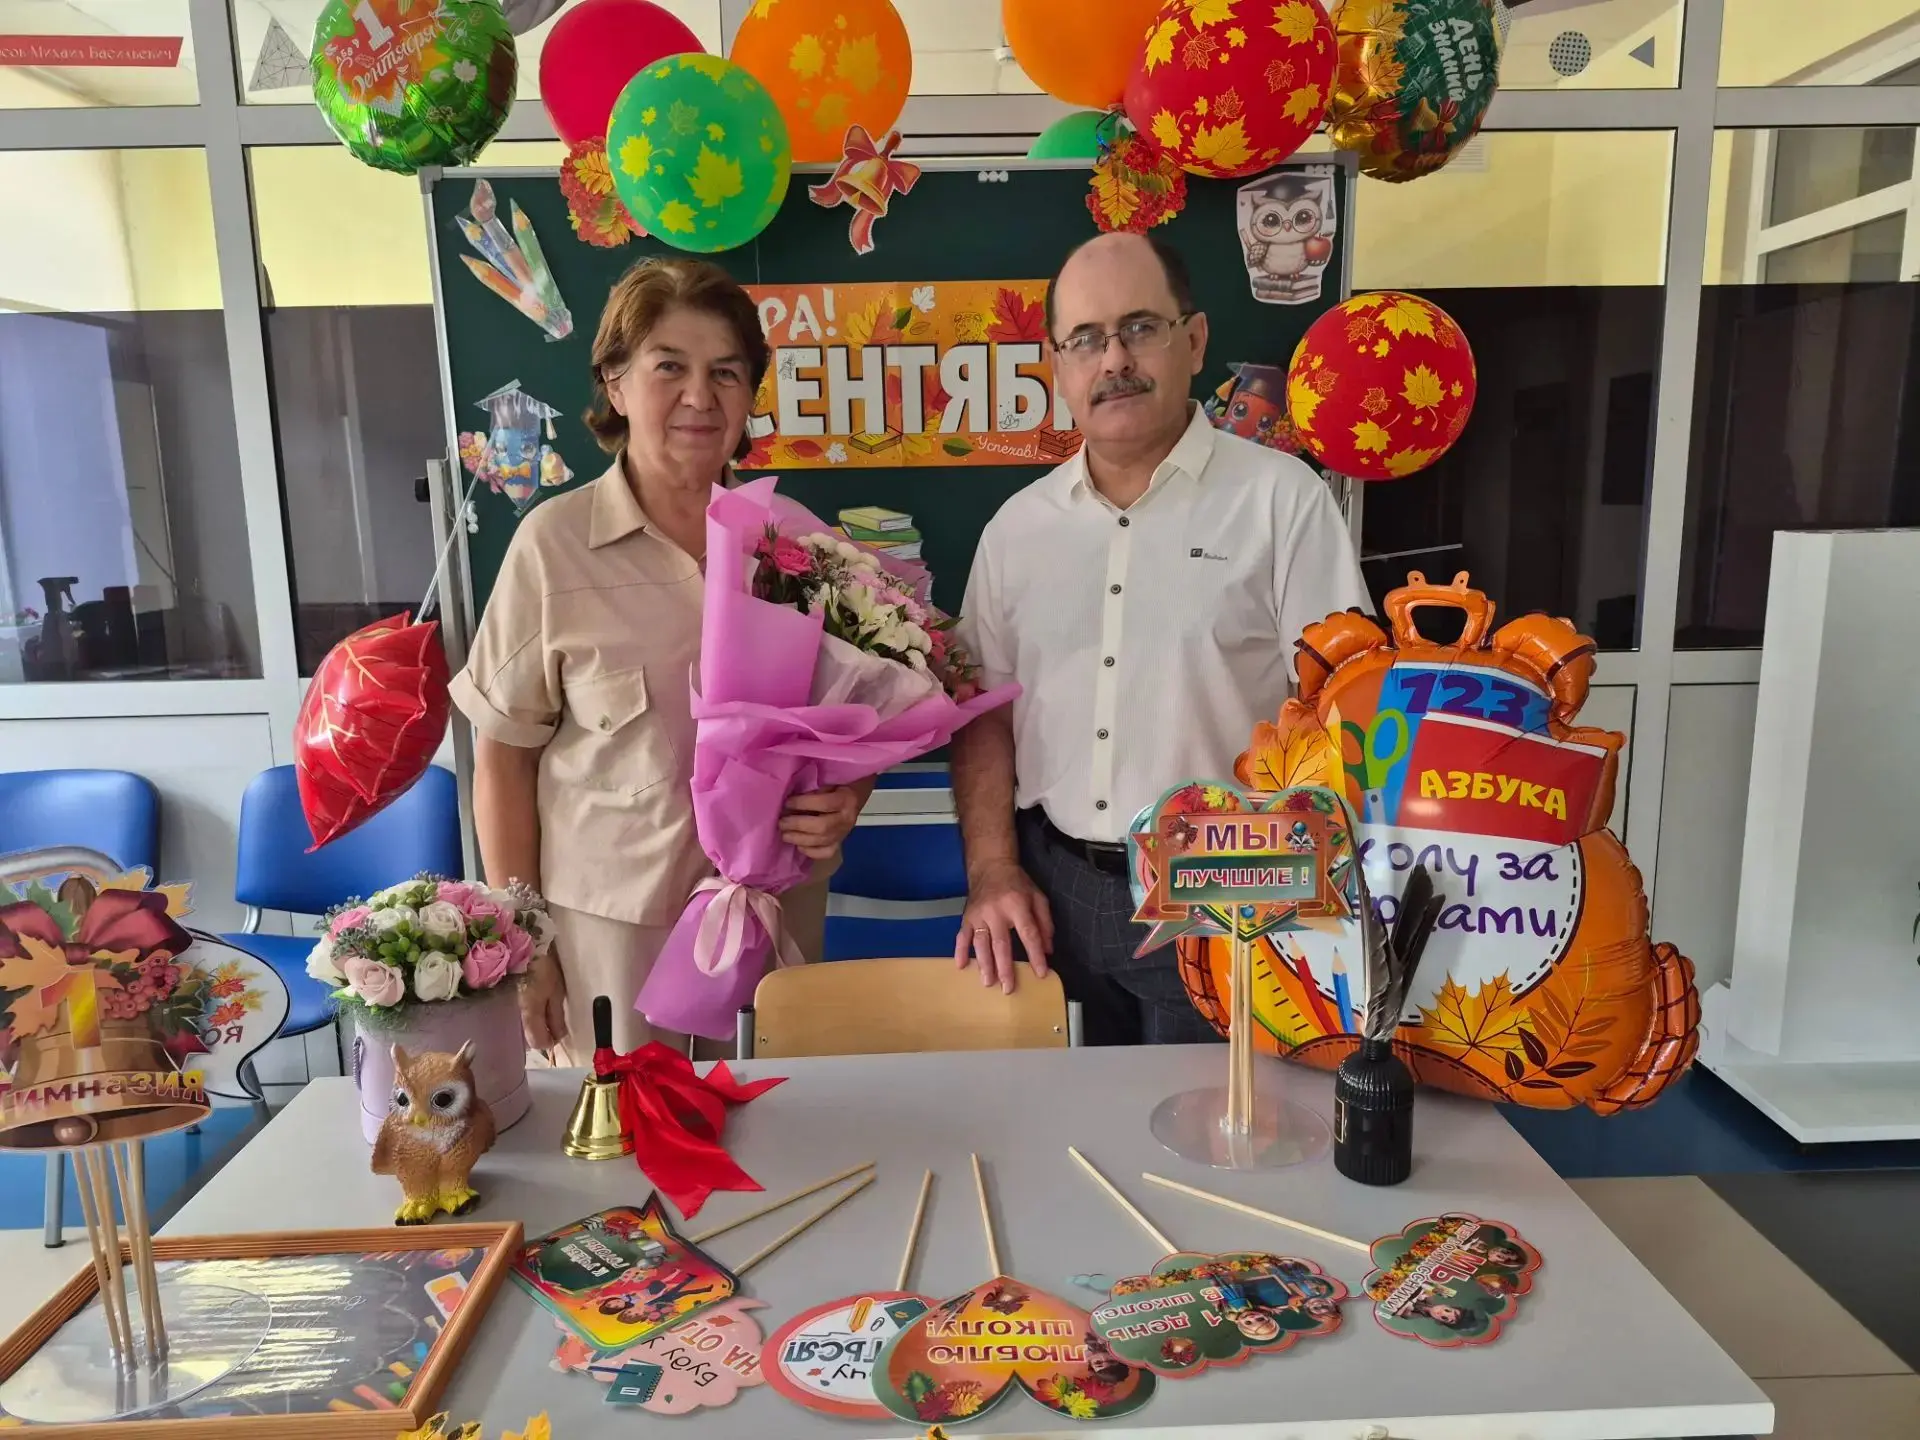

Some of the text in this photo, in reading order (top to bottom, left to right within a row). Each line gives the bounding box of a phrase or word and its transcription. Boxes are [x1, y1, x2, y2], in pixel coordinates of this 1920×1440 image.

[353, 0, 394, 51] 1
[1428, 20, 1466, 102] ЗНАНИЙ
[1447, 17, 1484, 91] ДЕНЬ
[757, 288, 837, 342] РА!
[747, 343, 1078, 438] ЕНТЯБ
[977, 435, 1038, 460] Успехов!
[1400, 672, 1530, 731] 123
[1420, 769, 1567, 821] АЗБУКА
[1205, 822, 1280, 852] МЫ
[1174, 867, 1293, 888] ЛУЧШИЕ
[1496, 852, 1559, 881] за
[1429, 1248, 1487, 1283] МЫ
[925, 1319, 1075, 1338] ШКОЛУ!
[1201, 1309, 1223, 1327] 1
[661, 1348, 718, 1387] Буду
[721, 1345, 760, 1377] НА
[784, 1340, 883, 1363] ТЬСЯ!
[927, 1344, 1089, 1365] ЛЮБЛЮ
[832, 1363, 868, 1380] чу
